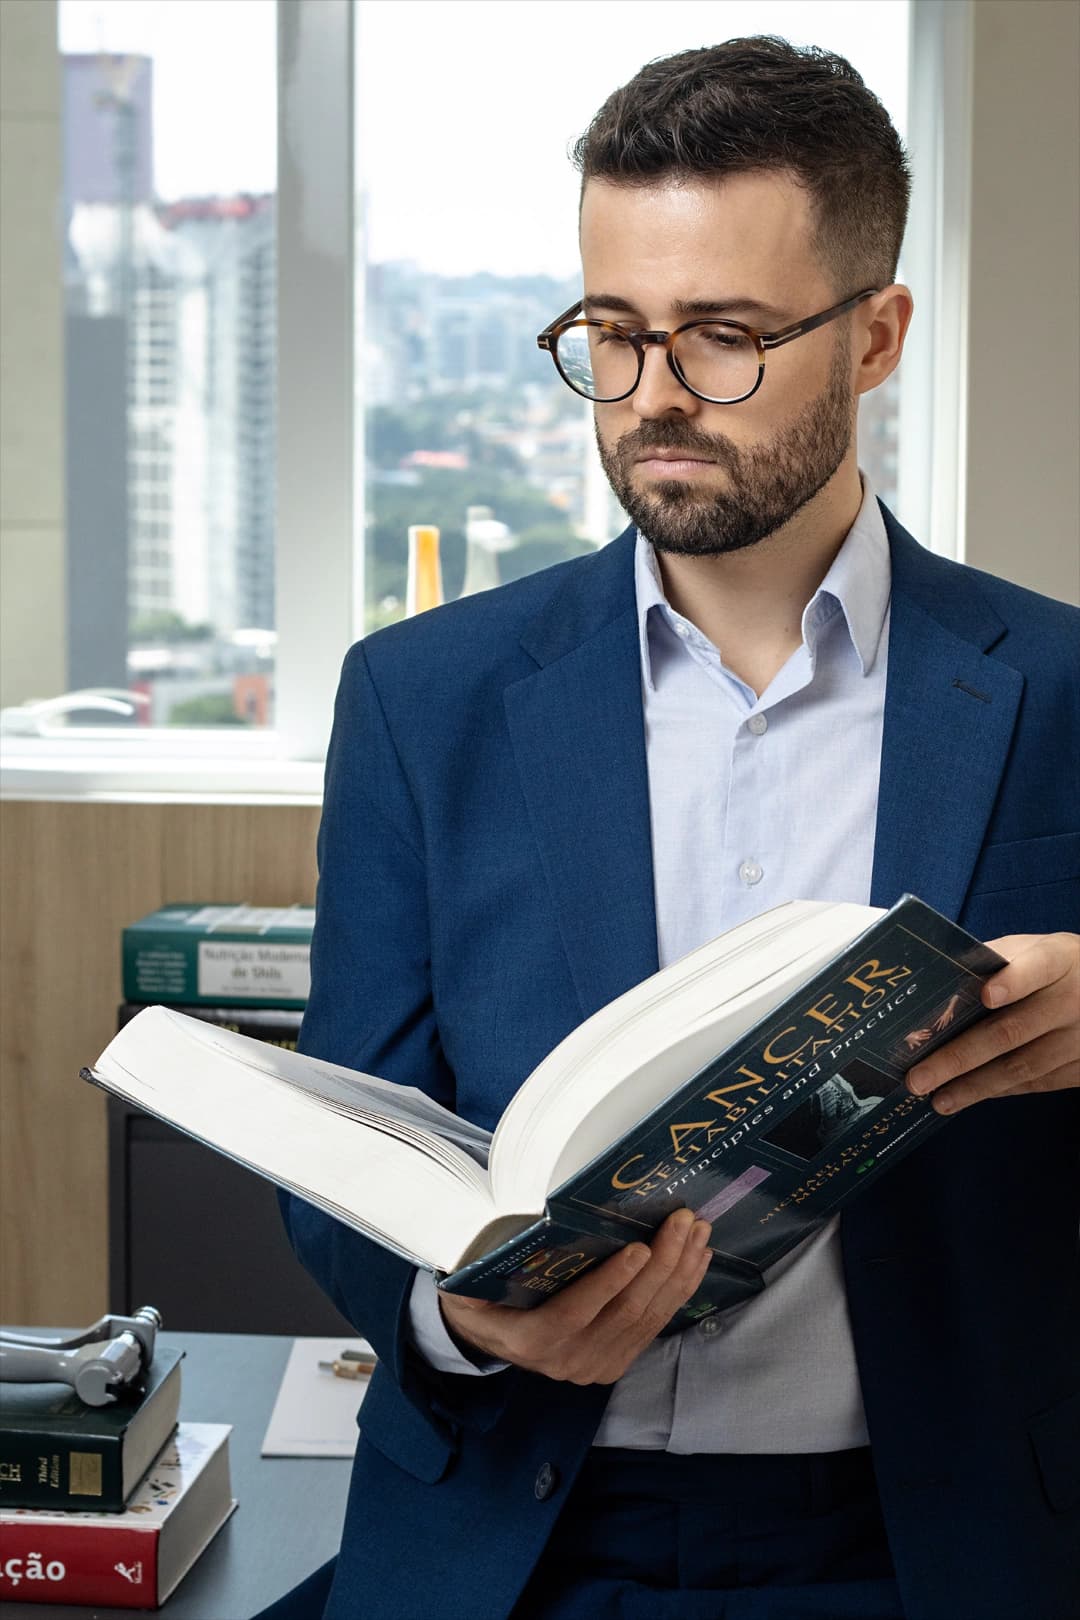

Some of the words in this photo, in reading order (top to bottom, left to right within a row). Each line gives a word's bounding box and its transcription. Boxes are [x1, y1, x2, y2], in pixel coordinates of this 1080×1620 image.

[611, 959, 901, 1190] CANCER
[635, 965, 912, 1197] REHABILITATION
[666, 1105, 775, 1195] Principles
[782, 1063, 822, 1100] and
[0, 1552, 66, 1586] ção
